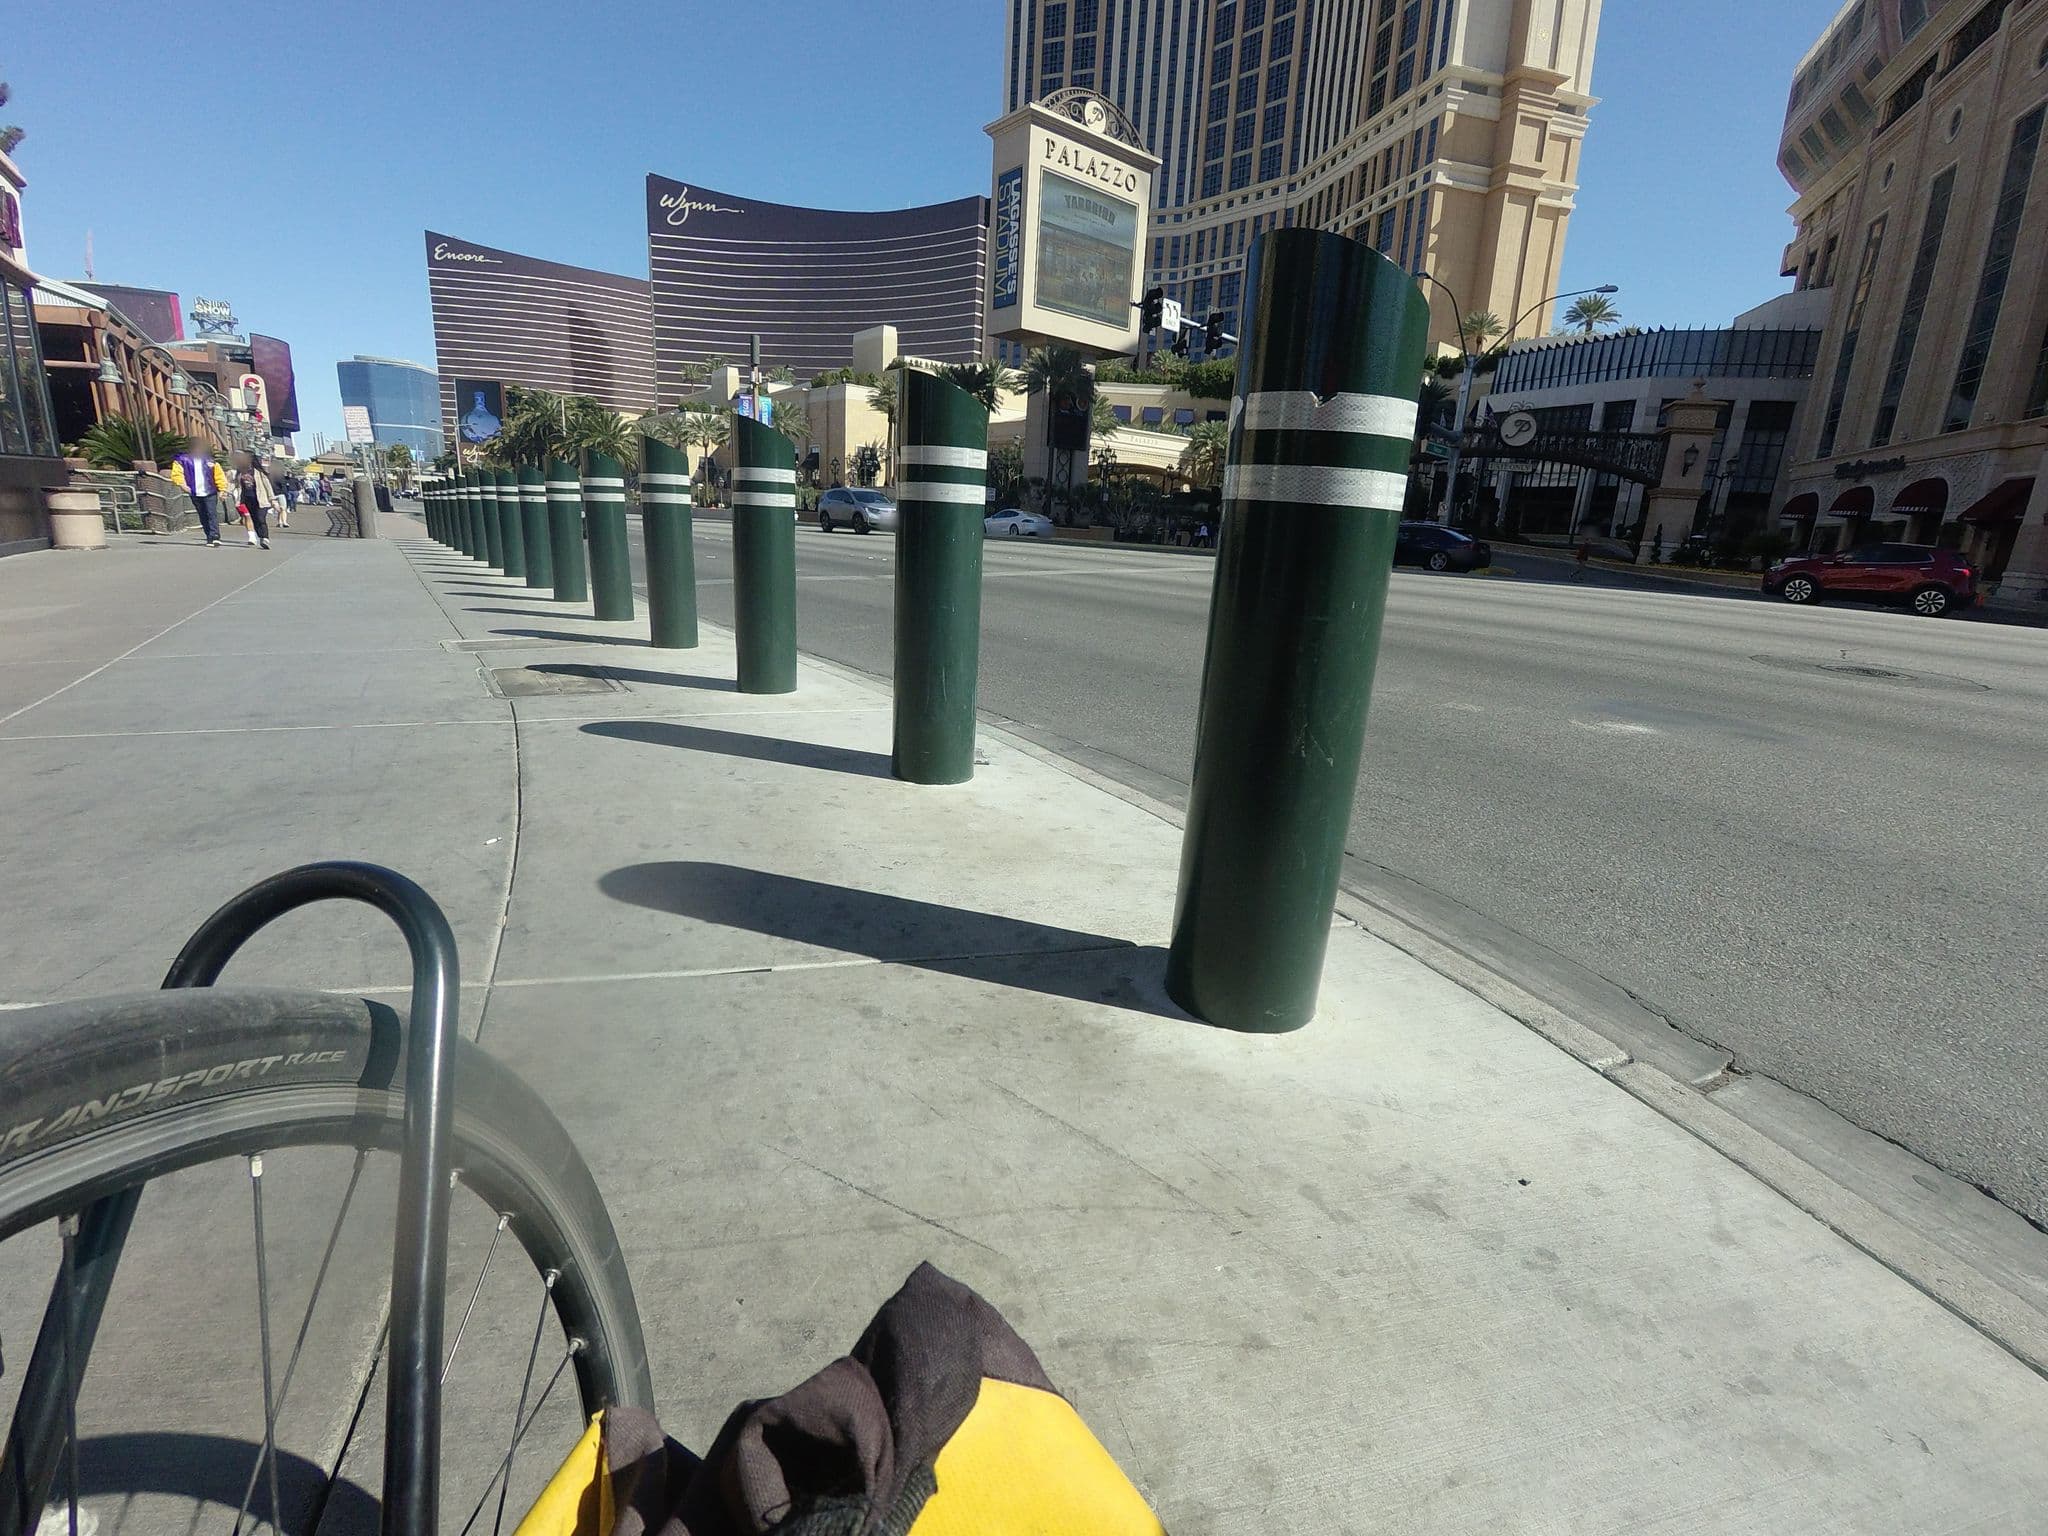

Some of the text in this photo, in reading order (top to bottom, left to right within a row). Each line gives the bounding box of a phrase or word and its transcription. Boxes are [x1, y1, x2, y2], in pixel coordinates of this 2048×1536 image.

[1045, 137, 1136, 193] PALAZZO
[659, 186, 744, 226] Wynn
[434, 242, 504, 264] Encore
[995, 182, 1011, 297] STADIUM
[1007, 176, 1022, 294] LAGASSE'S
[195, 304, 231, 316] SHOW
[0, 1050, 347, 1151] RANDSPORT RACE
